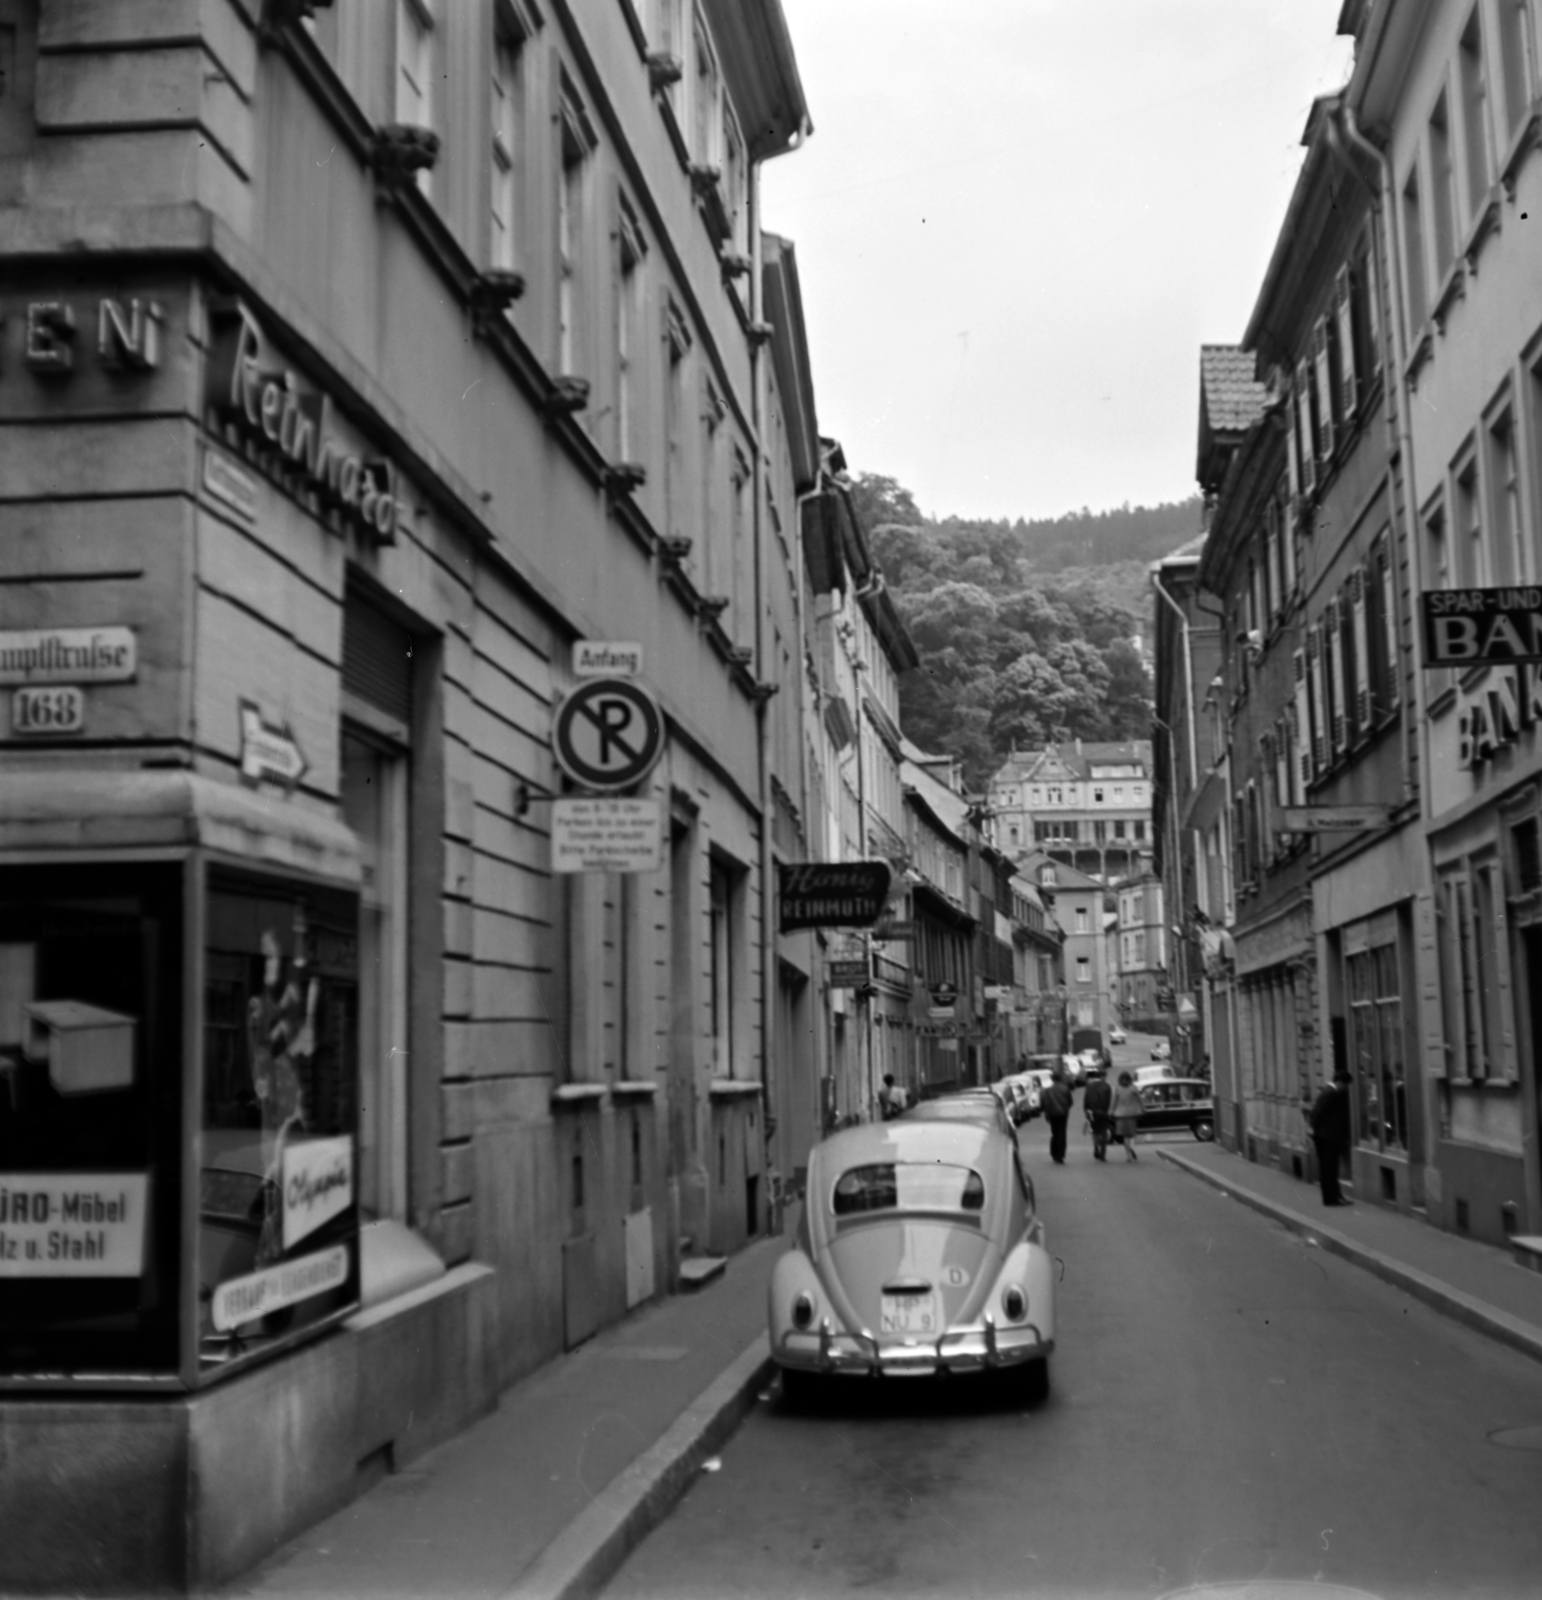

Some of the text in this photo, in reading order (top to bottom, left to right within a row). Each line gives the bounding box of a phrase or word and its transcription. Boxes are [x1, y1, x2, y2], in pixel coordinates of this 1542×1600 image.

[1433, 613, 1542, 660] BA
[580, 647, 637, 672] Anfang
[19, 692, 76, 726] 168
[47, 1230, 105, 1260] Stahl
